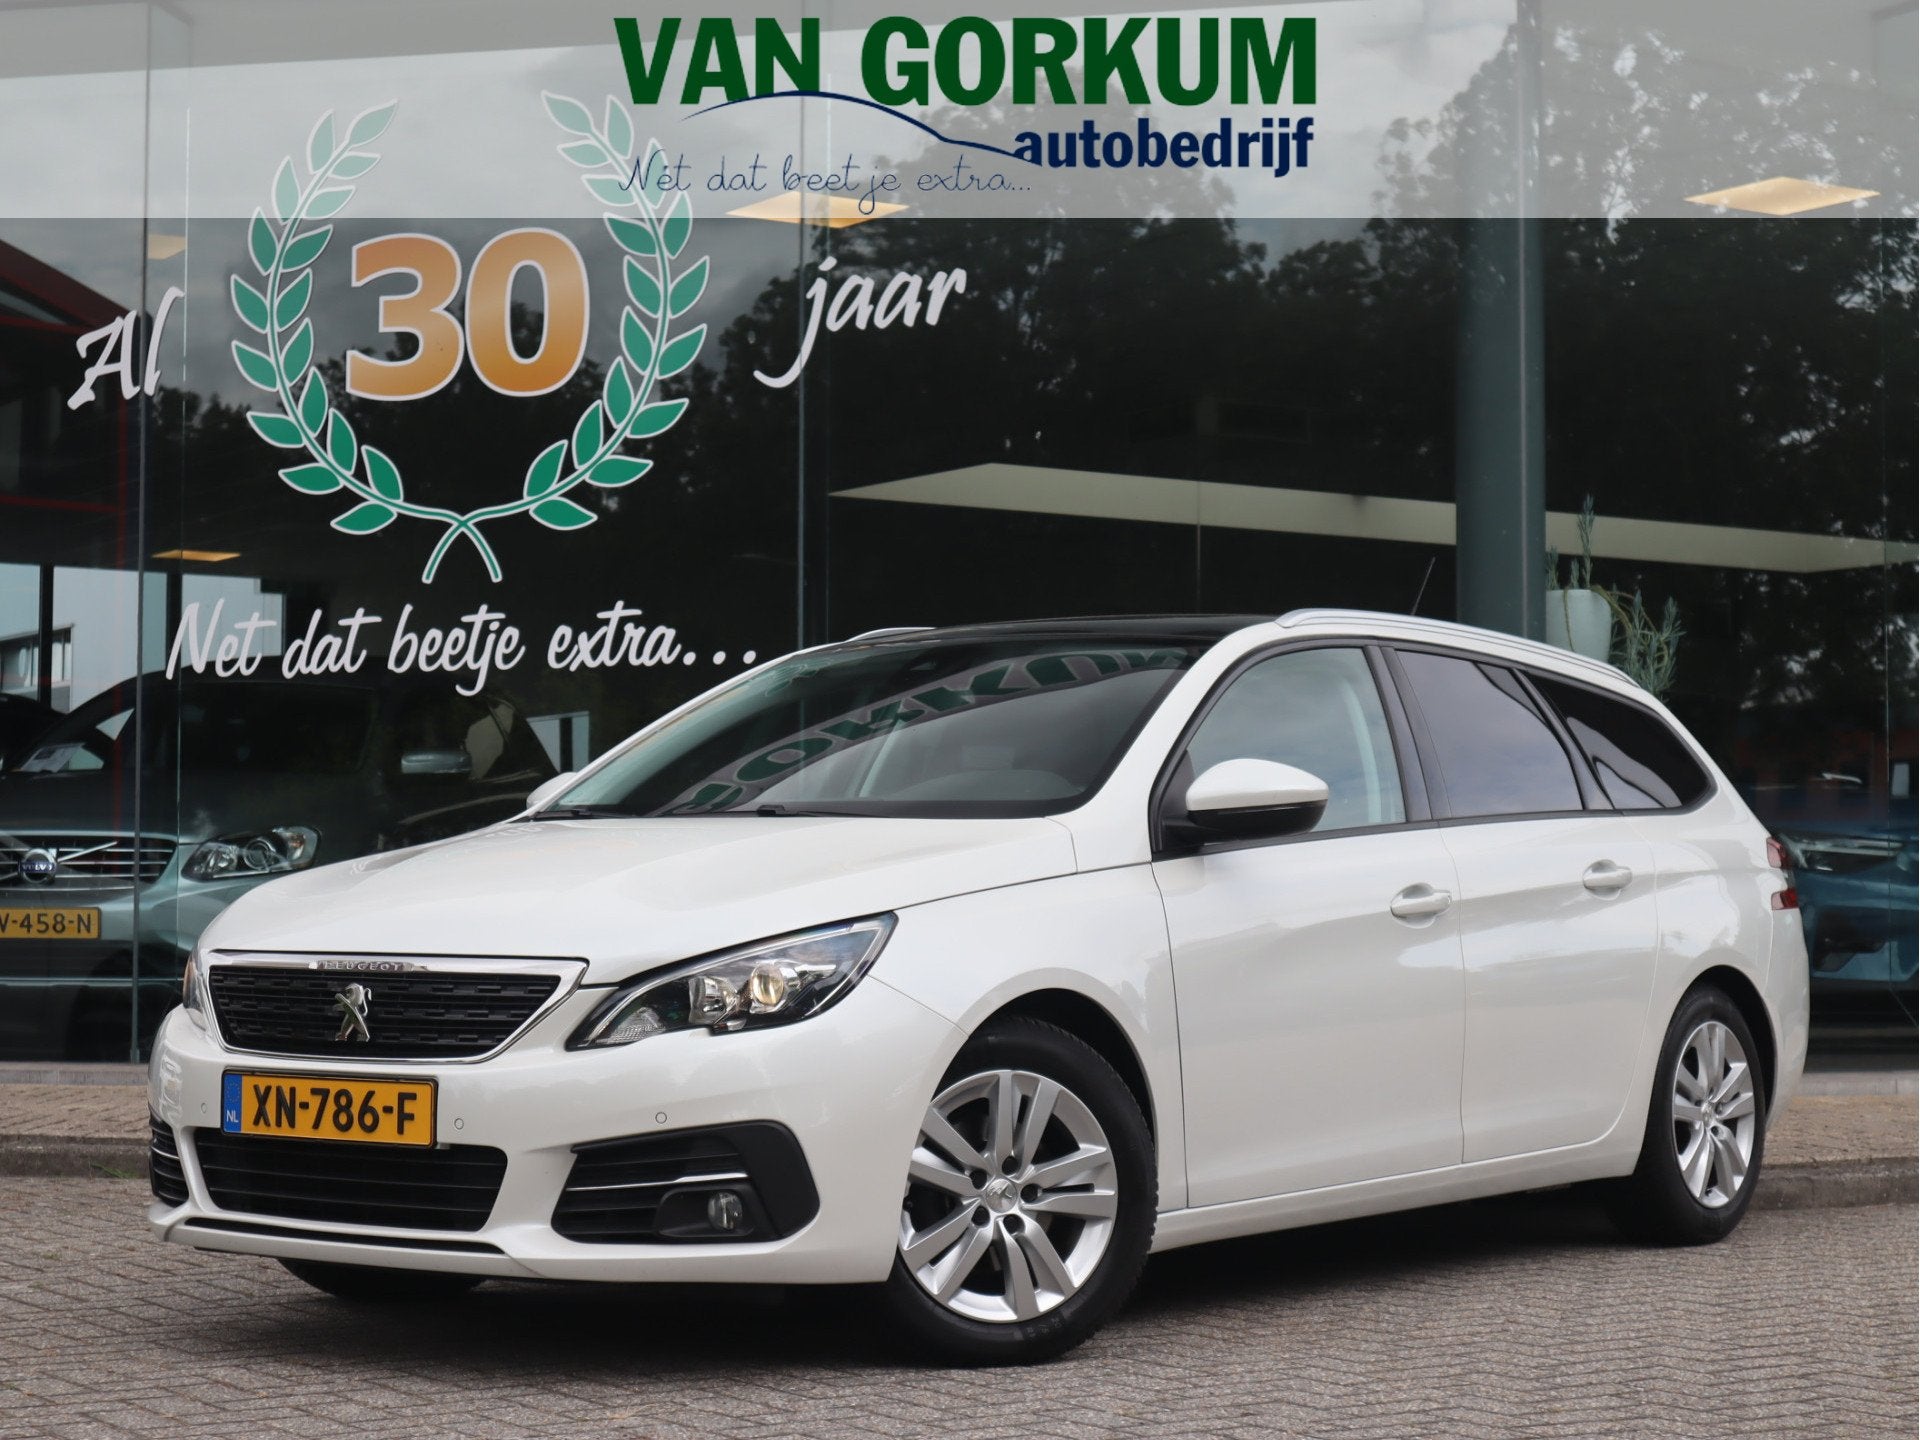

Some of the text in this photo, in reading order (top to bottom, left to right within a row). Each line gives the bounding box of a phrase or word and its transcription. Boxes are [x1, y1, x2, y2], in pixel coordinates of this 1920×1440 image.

[66, 226, 968, 411] Al 30 jaar
[165, 598, 758, 697] Net dat beetje extra...
[323, 960, 401, 972] PEUGEOT
[226, 1109, 239, 1124] NL
[252, 1083, 418, 1136] XN-786-F
